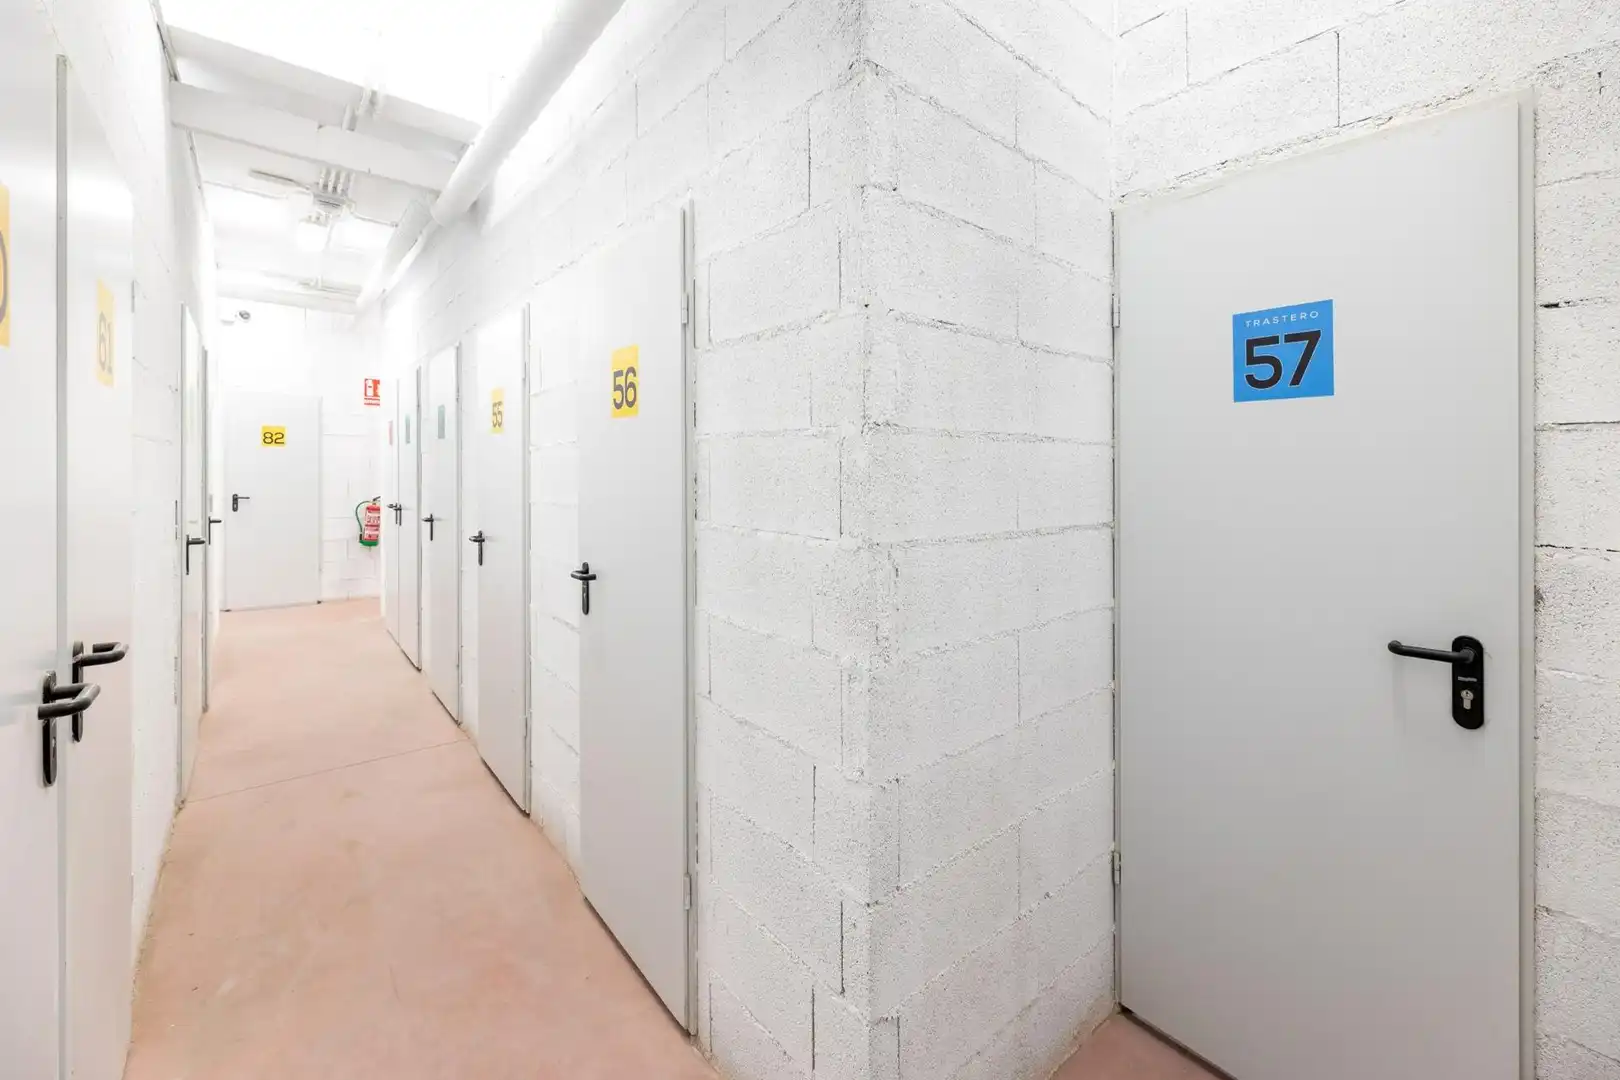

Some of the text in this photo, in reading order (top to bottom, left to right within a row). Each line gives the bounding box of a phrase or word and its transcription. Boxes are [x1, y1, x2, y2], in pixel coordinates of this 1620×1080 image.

[1245, 311, 1319, 328] TRASTERO
[98, 311, 113, 374] 61
[1245, 329, 1322, 389] 57
[613, 366, 637, 410] 56
[492, 401, 503, 428] 55
[263, 431, 285, 445] 82
